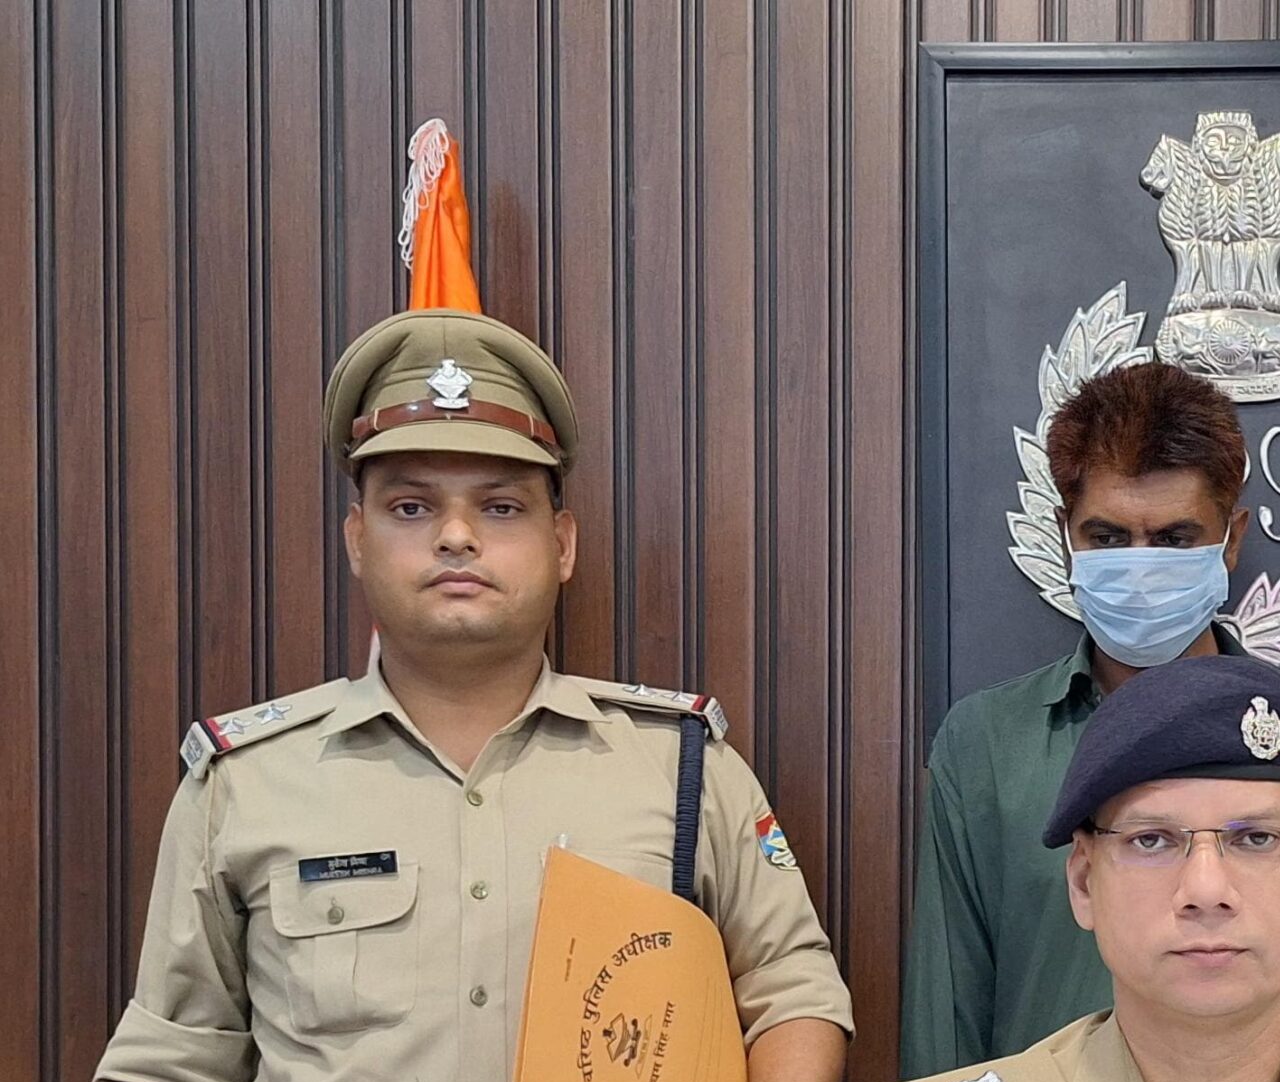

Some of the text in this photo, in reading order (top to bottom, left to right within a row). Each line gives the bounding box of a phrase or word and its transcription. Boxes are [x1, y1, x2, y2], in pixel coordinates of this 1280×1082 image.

[582, 964, 613, 1025] पुलिस
[611, 931, 672, 967] अधीक्षक
[662, 1000, 676, 1028] नगर
